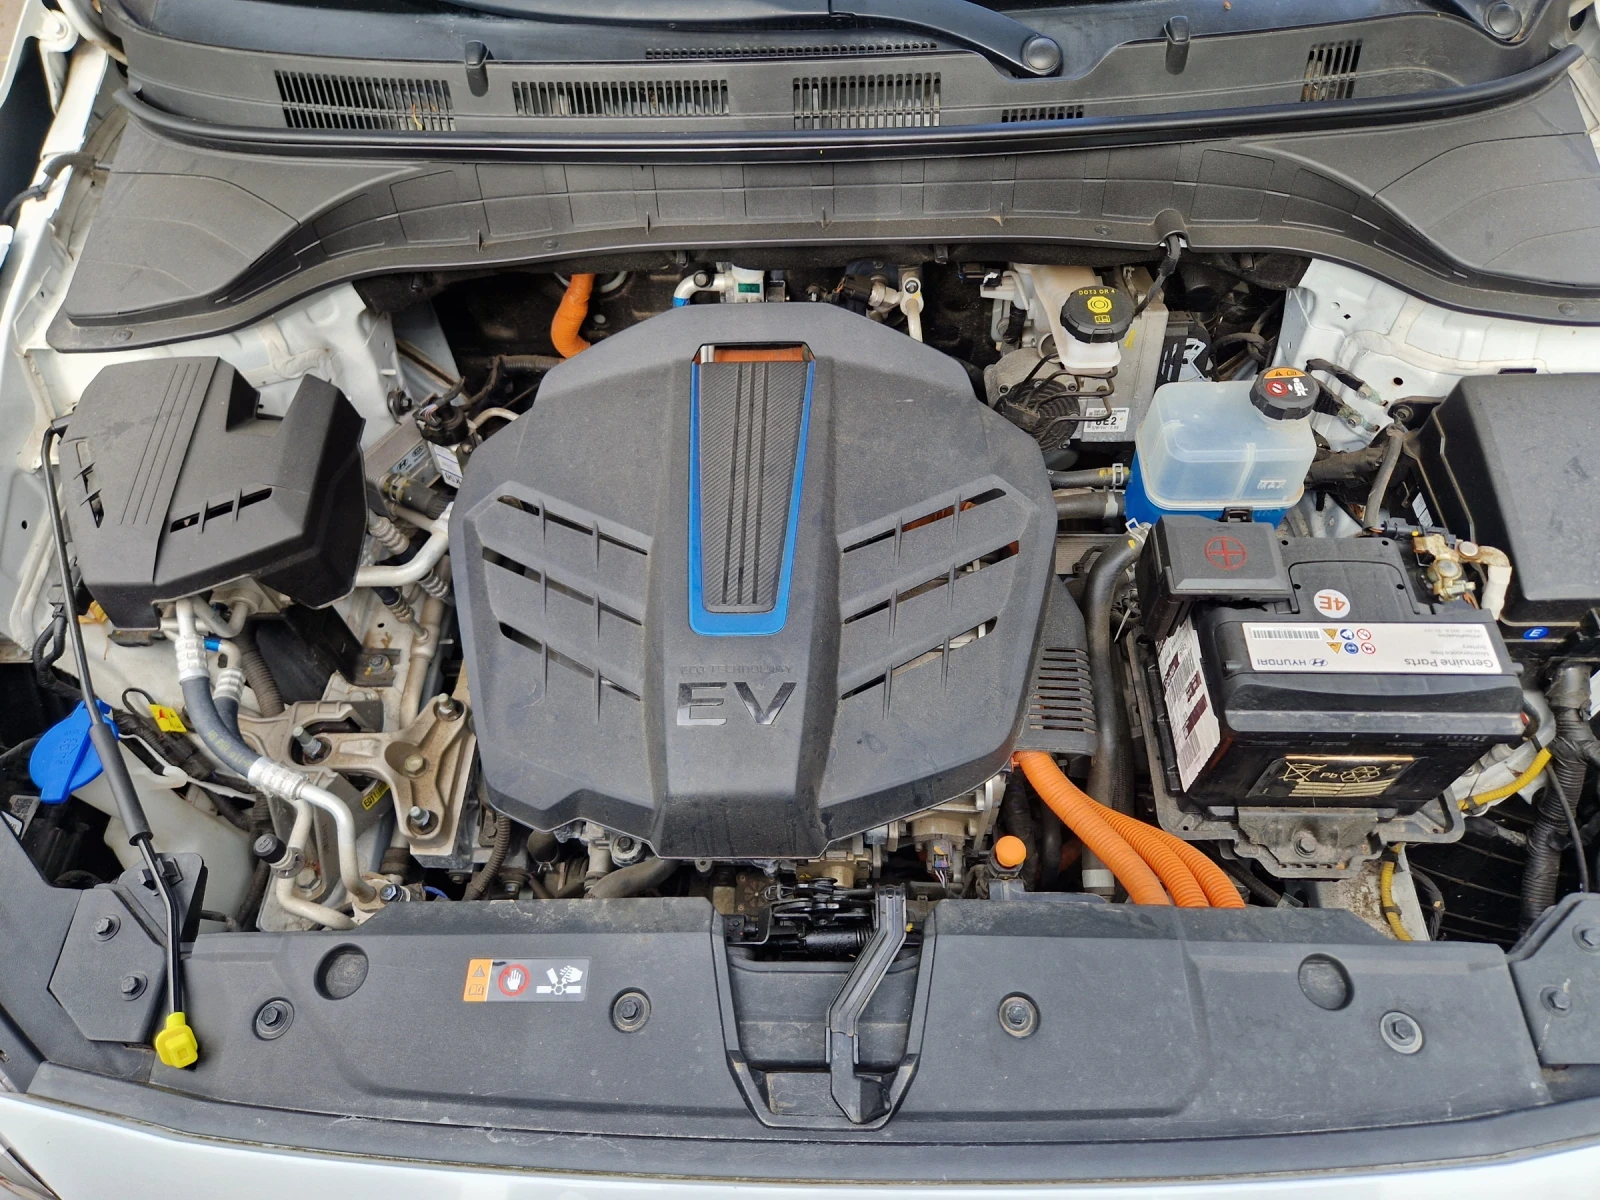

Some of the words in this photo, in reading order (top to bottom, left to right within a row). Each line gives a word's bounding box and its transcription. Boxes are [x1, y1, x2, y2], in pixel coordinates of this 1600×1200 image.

[1318, 595, 1346, 611] 4E
[1529, 628, 1542, 637] E
[1256, 658, 1307, 666] HYUNDAI
[1404, 658, 1438, 667] Parts
[1440, 658, 1494, 668] Genuine
[680, 666, 705, 675] ECO
[677, 682, 797, 726] EV
